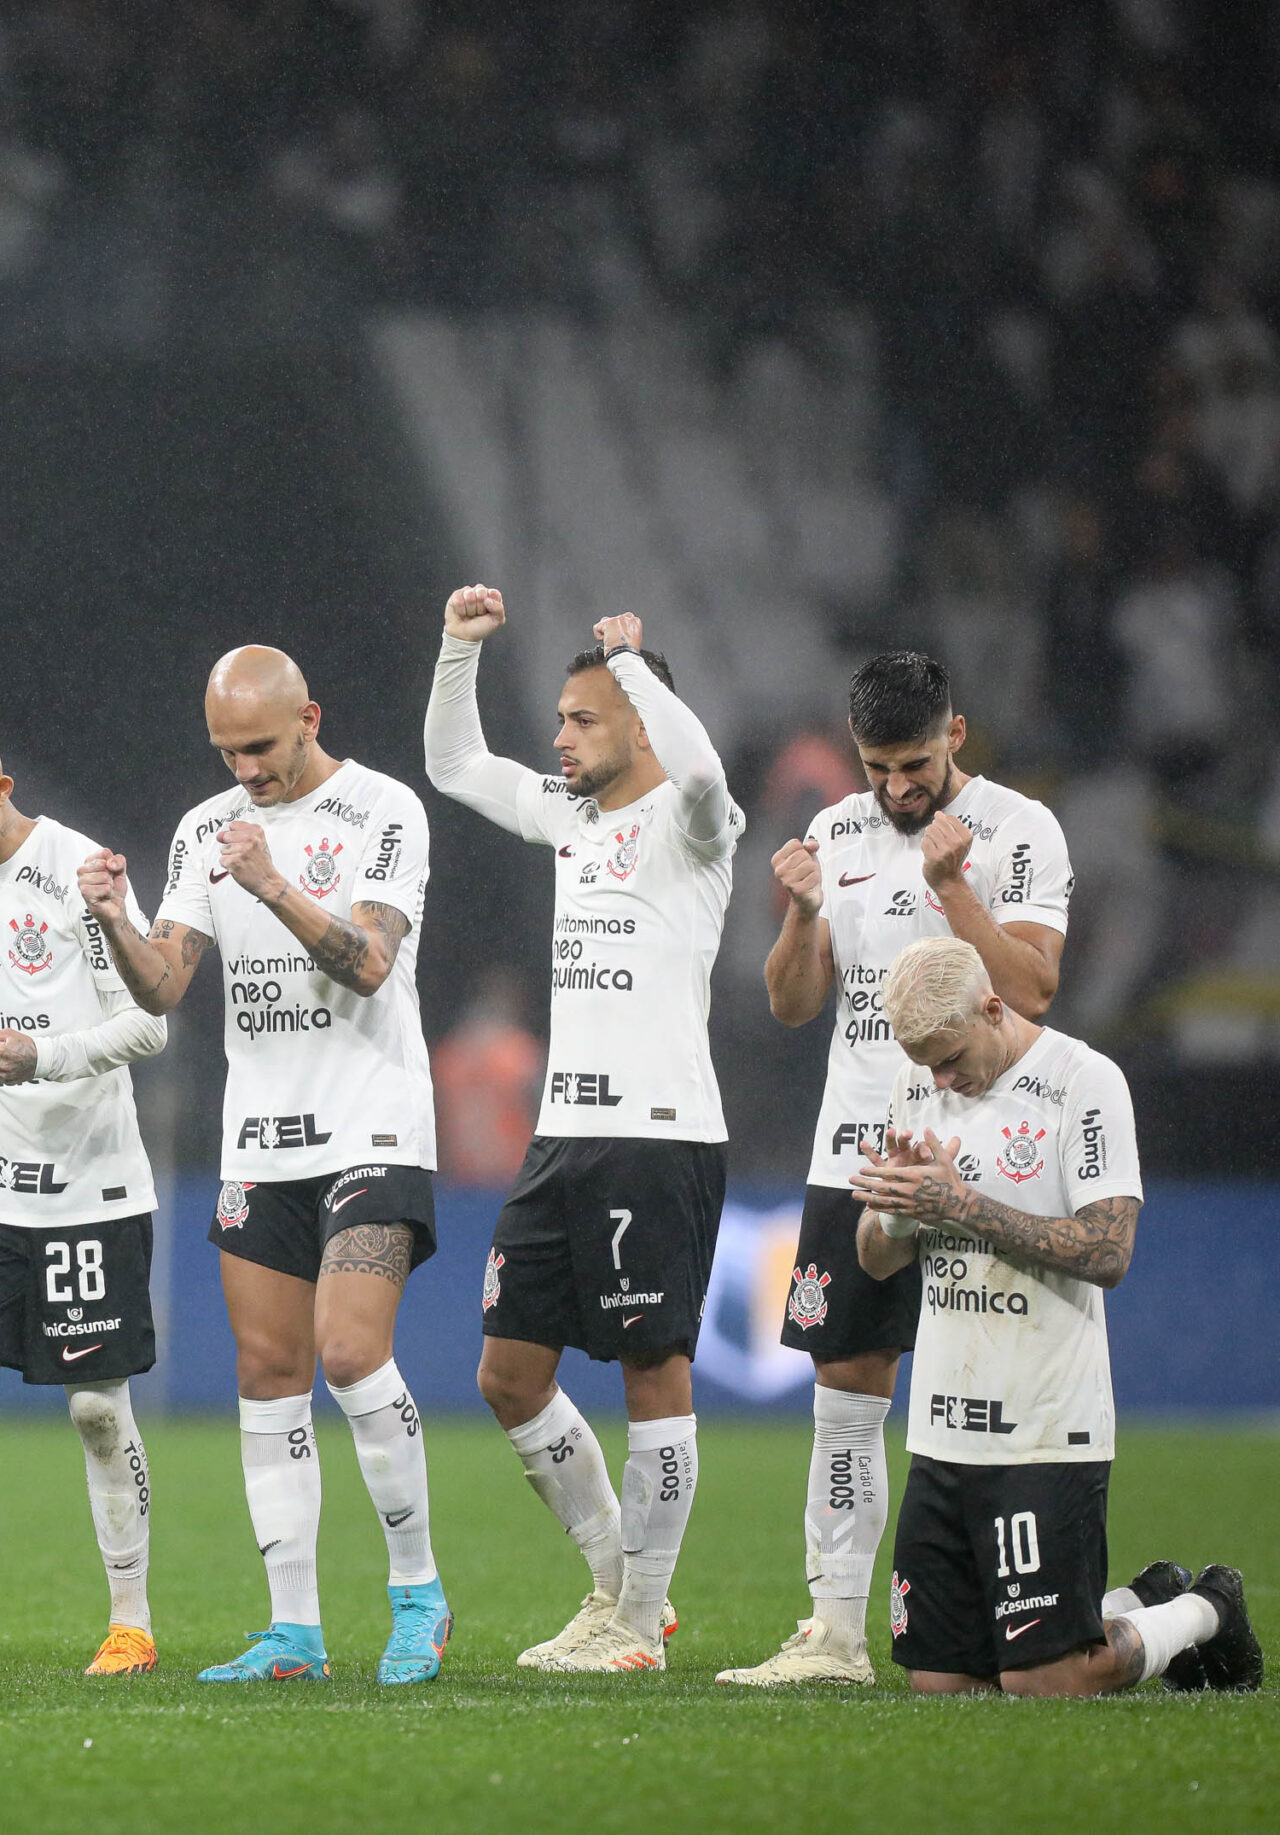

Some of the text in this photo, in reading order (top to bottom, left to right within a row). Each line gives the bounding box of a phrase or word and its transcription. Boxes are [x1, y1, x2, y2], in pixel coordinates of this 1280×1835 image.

[314, 797, 370, 830] pixbet
[365, 838, 401, 880] bmg
[580, 875, 596, 884] ALE
[16, 865, 69, 904] pixbet
[1001, 859, 1031, 903] bmg
[884, 907, 916, 916] ALE
[231, 980, 282, 1005] neo
[237, 1004, 332, 1041] química
[1078, 1125, 1102, 1180] bmg
[609, 1208, 632, 1270] 7
[45, 1239, 106, 1302] 28
[925, 1255, 967, 1280] neo
[600, 1292, 664, 1309] UniCesumar
[928, 1282, 1028, 1315] química
[124, 1440, 149, 1516] TODOS
[660, 1446, 680, 1501] ODOS
[829, 1449, 854, 1510] TODOS
[858, 1456, 876, 1503] Cartão de
[995, 1511, 1041, 1578] 10
